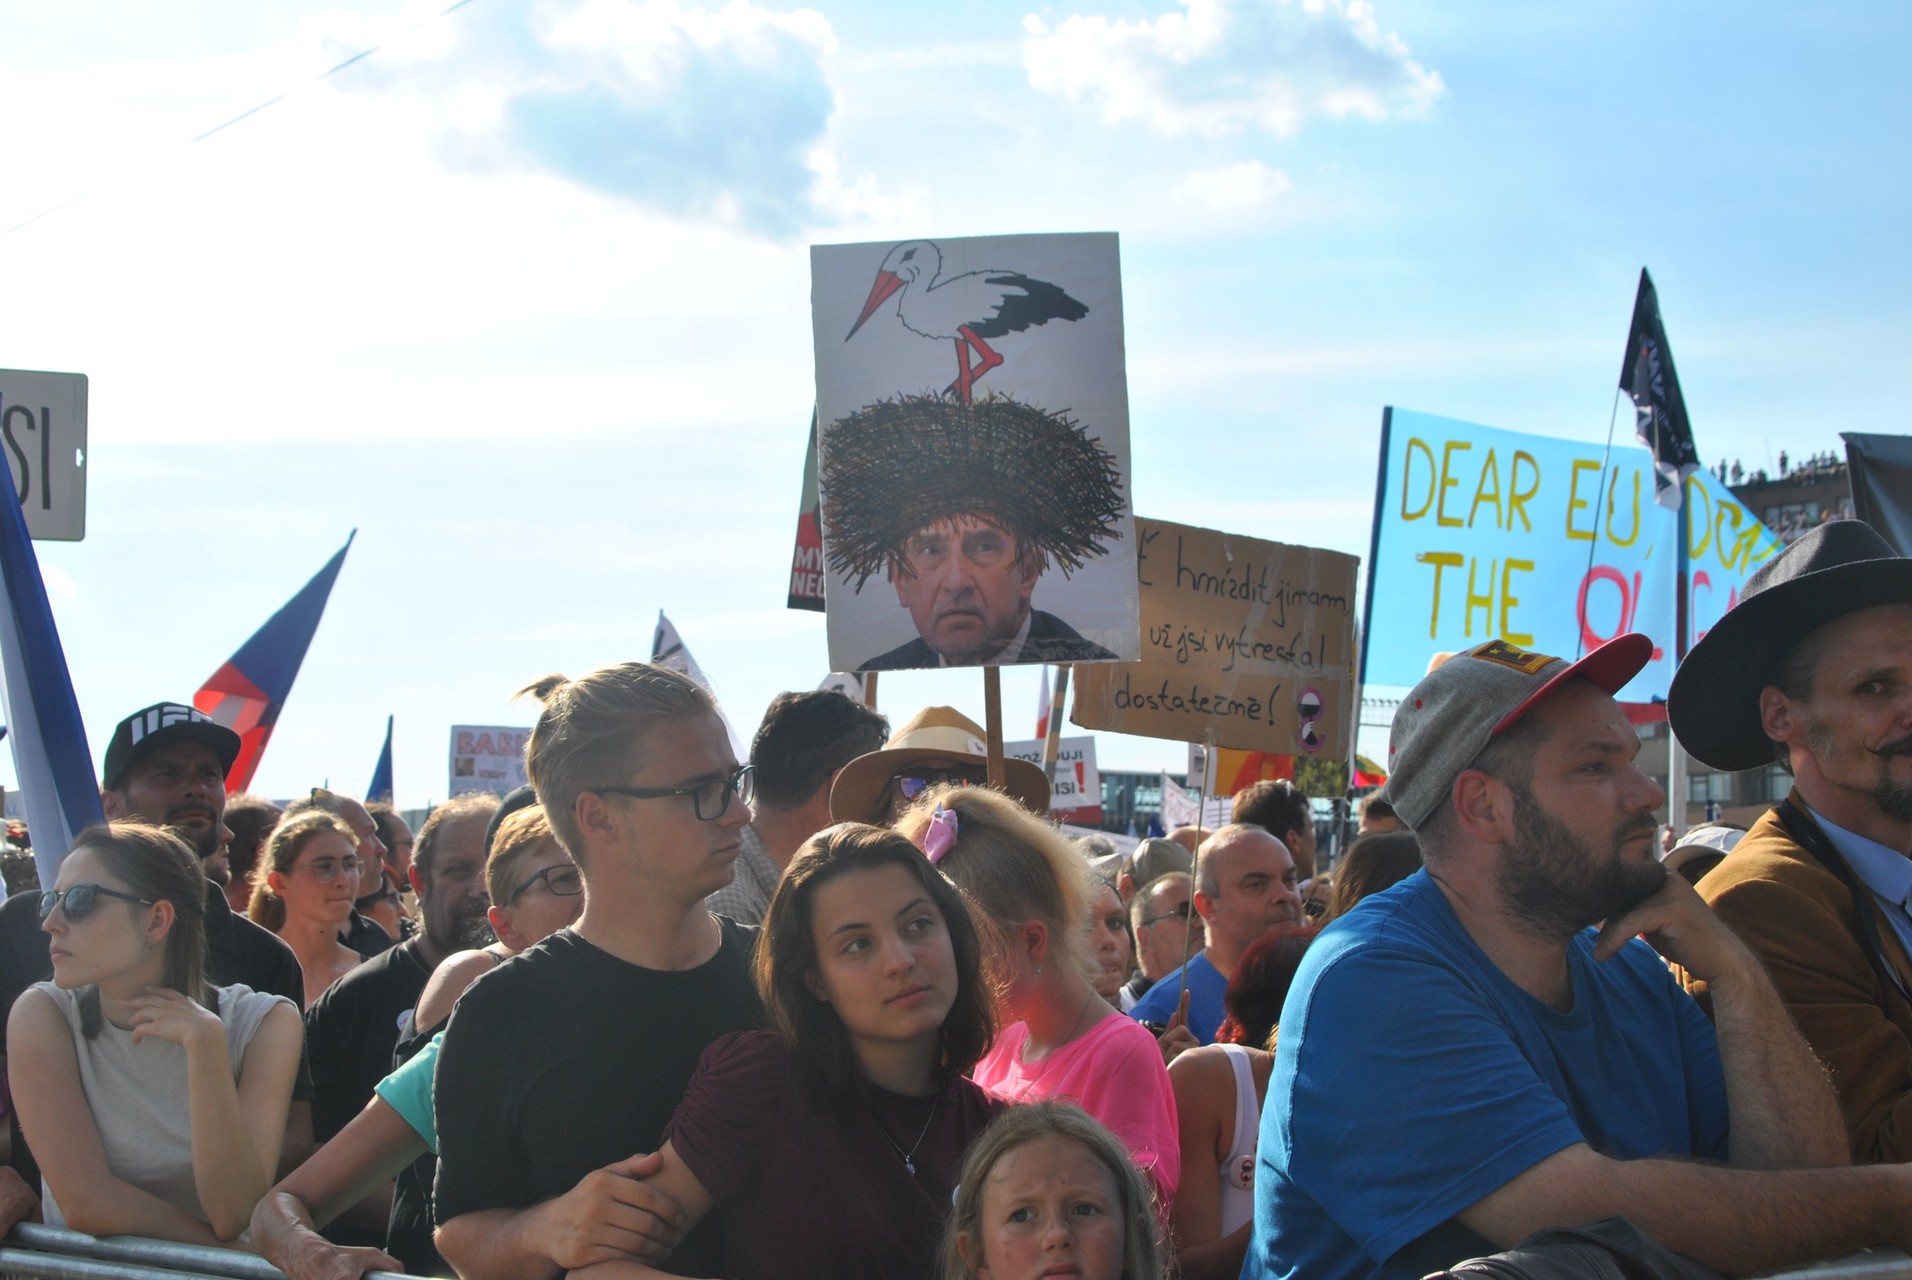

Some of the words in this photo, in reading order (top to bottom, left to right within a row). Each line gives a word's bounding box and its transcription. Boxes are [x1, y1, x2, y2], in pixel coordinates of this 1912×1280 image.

[1400, 436, 1541, 533] DEAR
[1566, 459, 1655, 561] EU,
[795, 544, 824, 571] MY
[1415, 551, 1536, 647] THE
